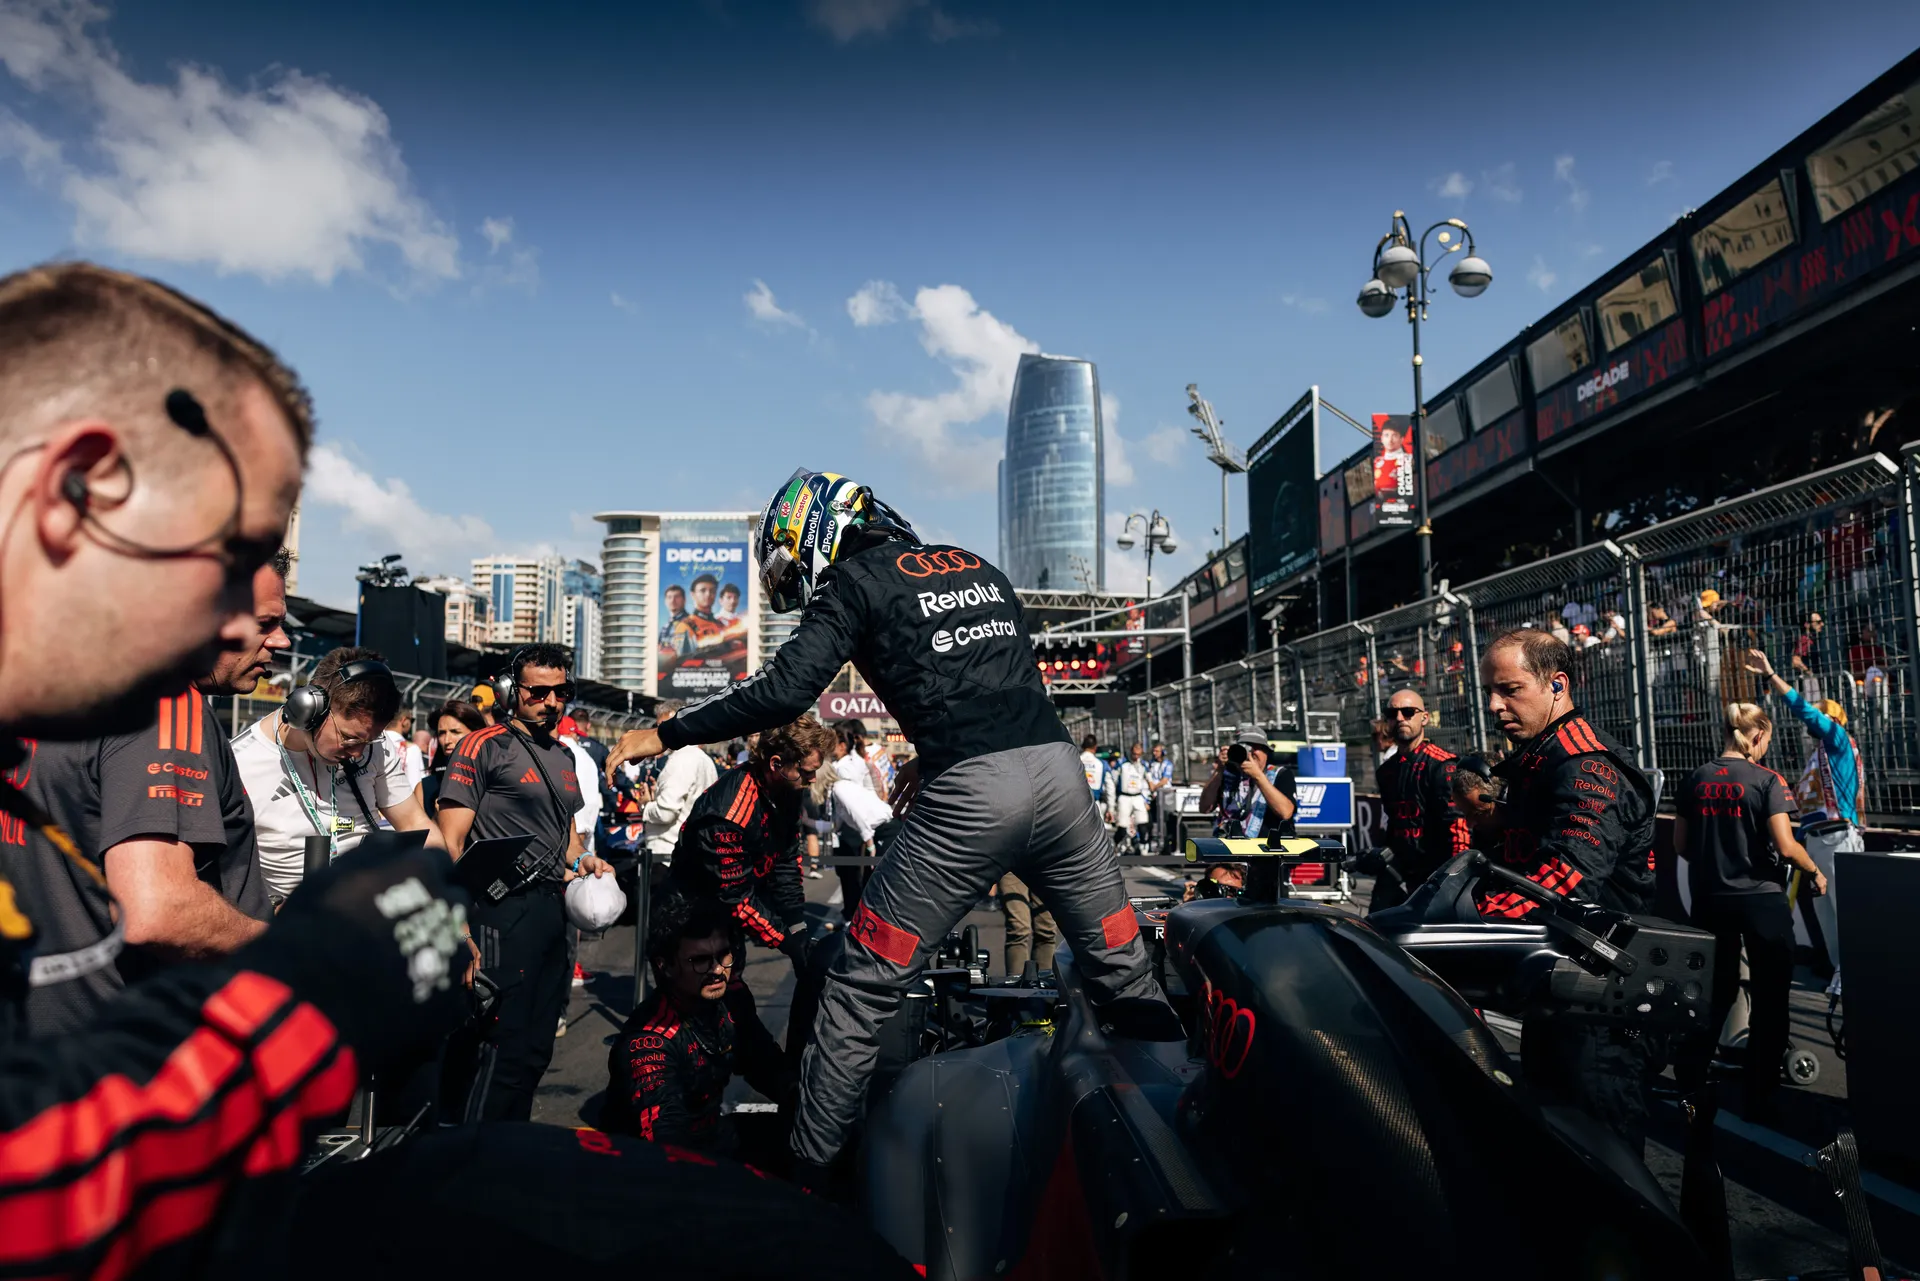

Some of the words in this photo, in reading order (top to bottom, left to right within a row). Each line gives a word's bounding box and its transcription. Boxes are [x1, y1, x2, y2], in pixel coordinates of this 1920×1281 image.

[1577, 361, 1629, 402] DECADE
[795, 493, 809, 519] Castrol
[804, 510, 821, 548] Revolut
[823, 520, 836, 546] Porto
[666, 548, 743, 563] DECADE
[917, 582, 1005, 618] Revolut
[955, 619, 1018, 646] Castrol
[162, 762, 209, 781] Castrol
[148, 784, 205, 807] PIRELLI
